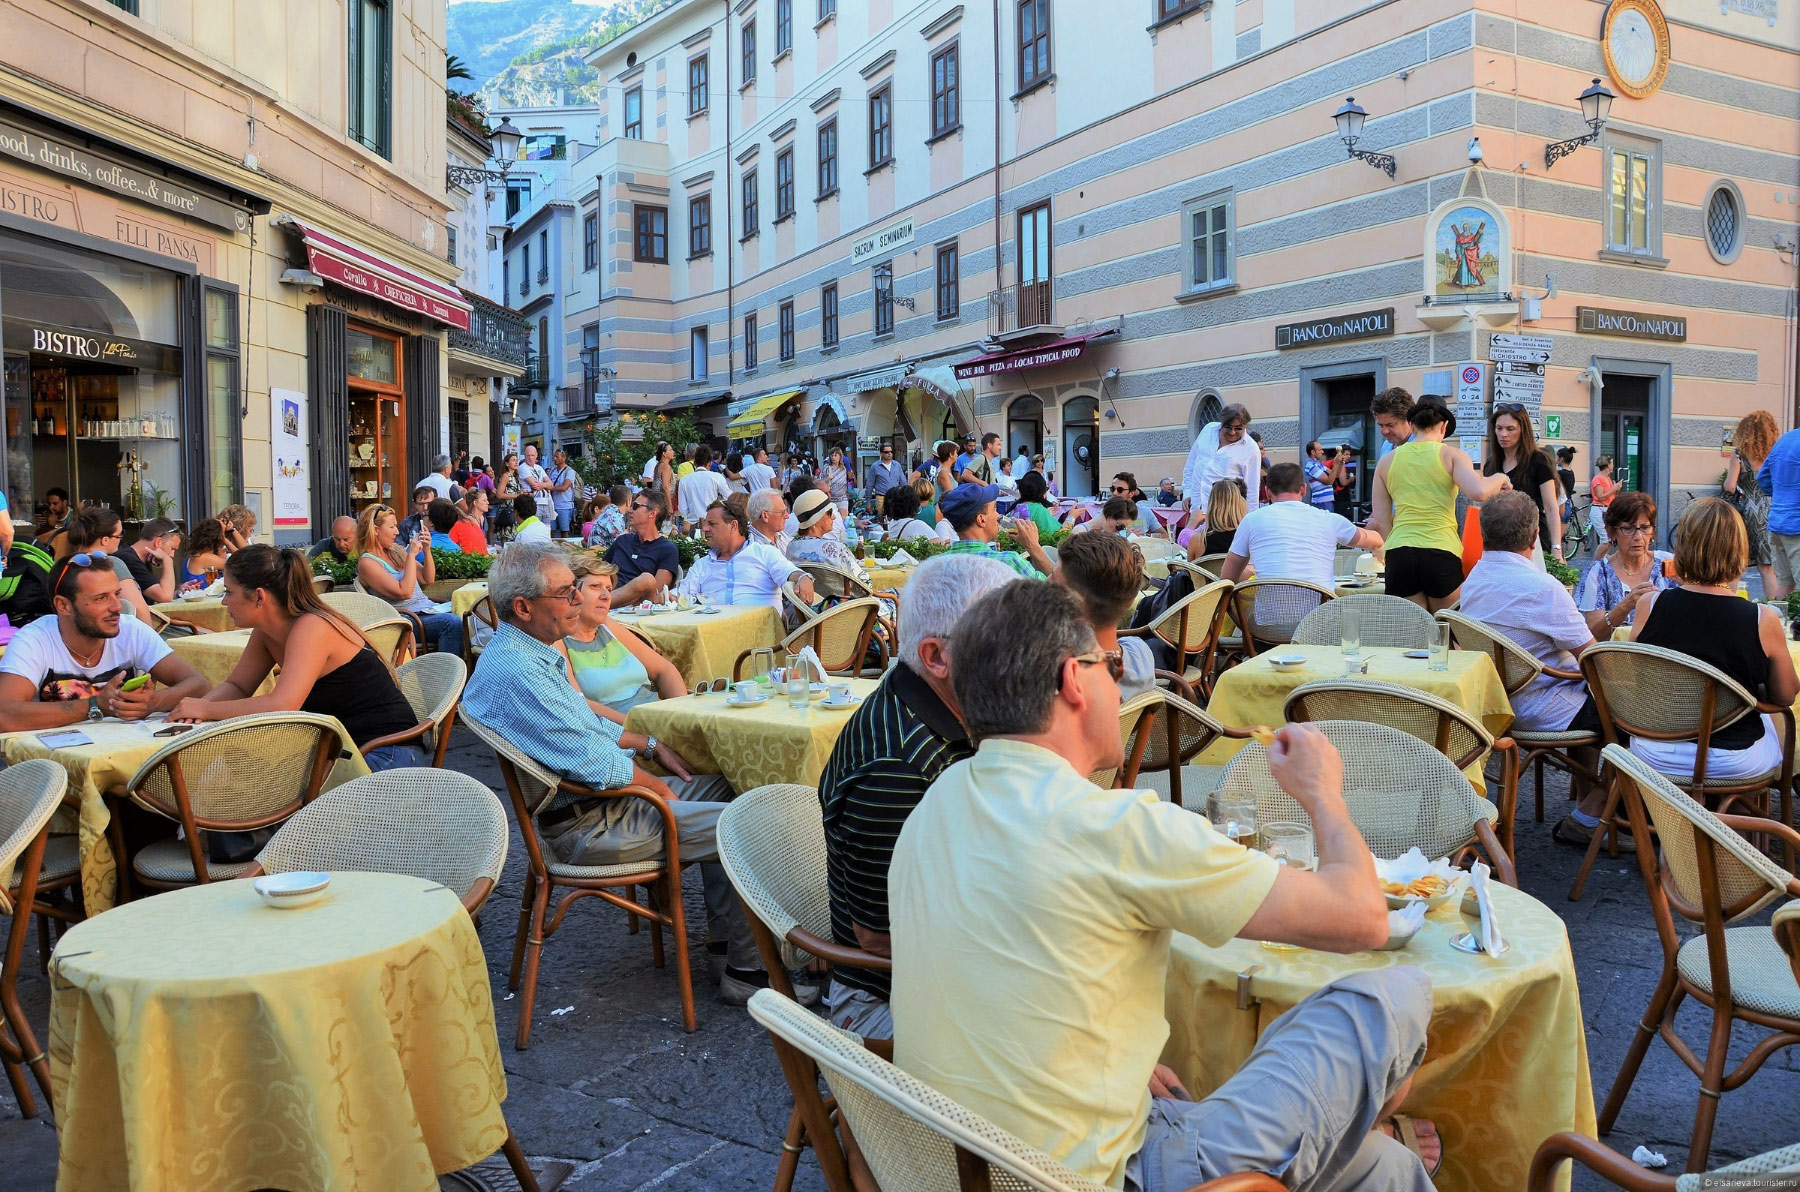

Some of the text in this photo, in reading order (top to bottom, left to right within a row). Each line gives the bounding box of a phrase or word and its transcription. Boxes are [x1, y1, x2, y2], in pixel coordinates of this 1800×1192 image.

[0, 134, 35, 161] ood,
[40, 142, 91, 180] drinks,
[0, 187, 58, 221] ISTRO
[157, 233, 200, 262] PANSA
[855, 224, 913, 258] SACRUM SEMINARIUM
[343, 268, 367, 287] Corallo
[1293, 323, 1333, 342] BANCO
[1344, 314, 1388, 335] NAPOLI
[1598, 313, 1636, 332] BANCO
[1646, 319, 1684, 337] NAPOLI
[33, 328, 100, 359] BISTRO
[1498, 353, 1527, 361] CHIOSTRO
[958, 367, 973, 377] WINE
[974, 365, 985, 375] BAR
[989, 361, 1005, 373] PIZZA
[1014, 356, 1034, 368] LOCAL
[1035, 353, 1060, 364] TYPICAL
[1061, 347, 1081, 359] FOOD
